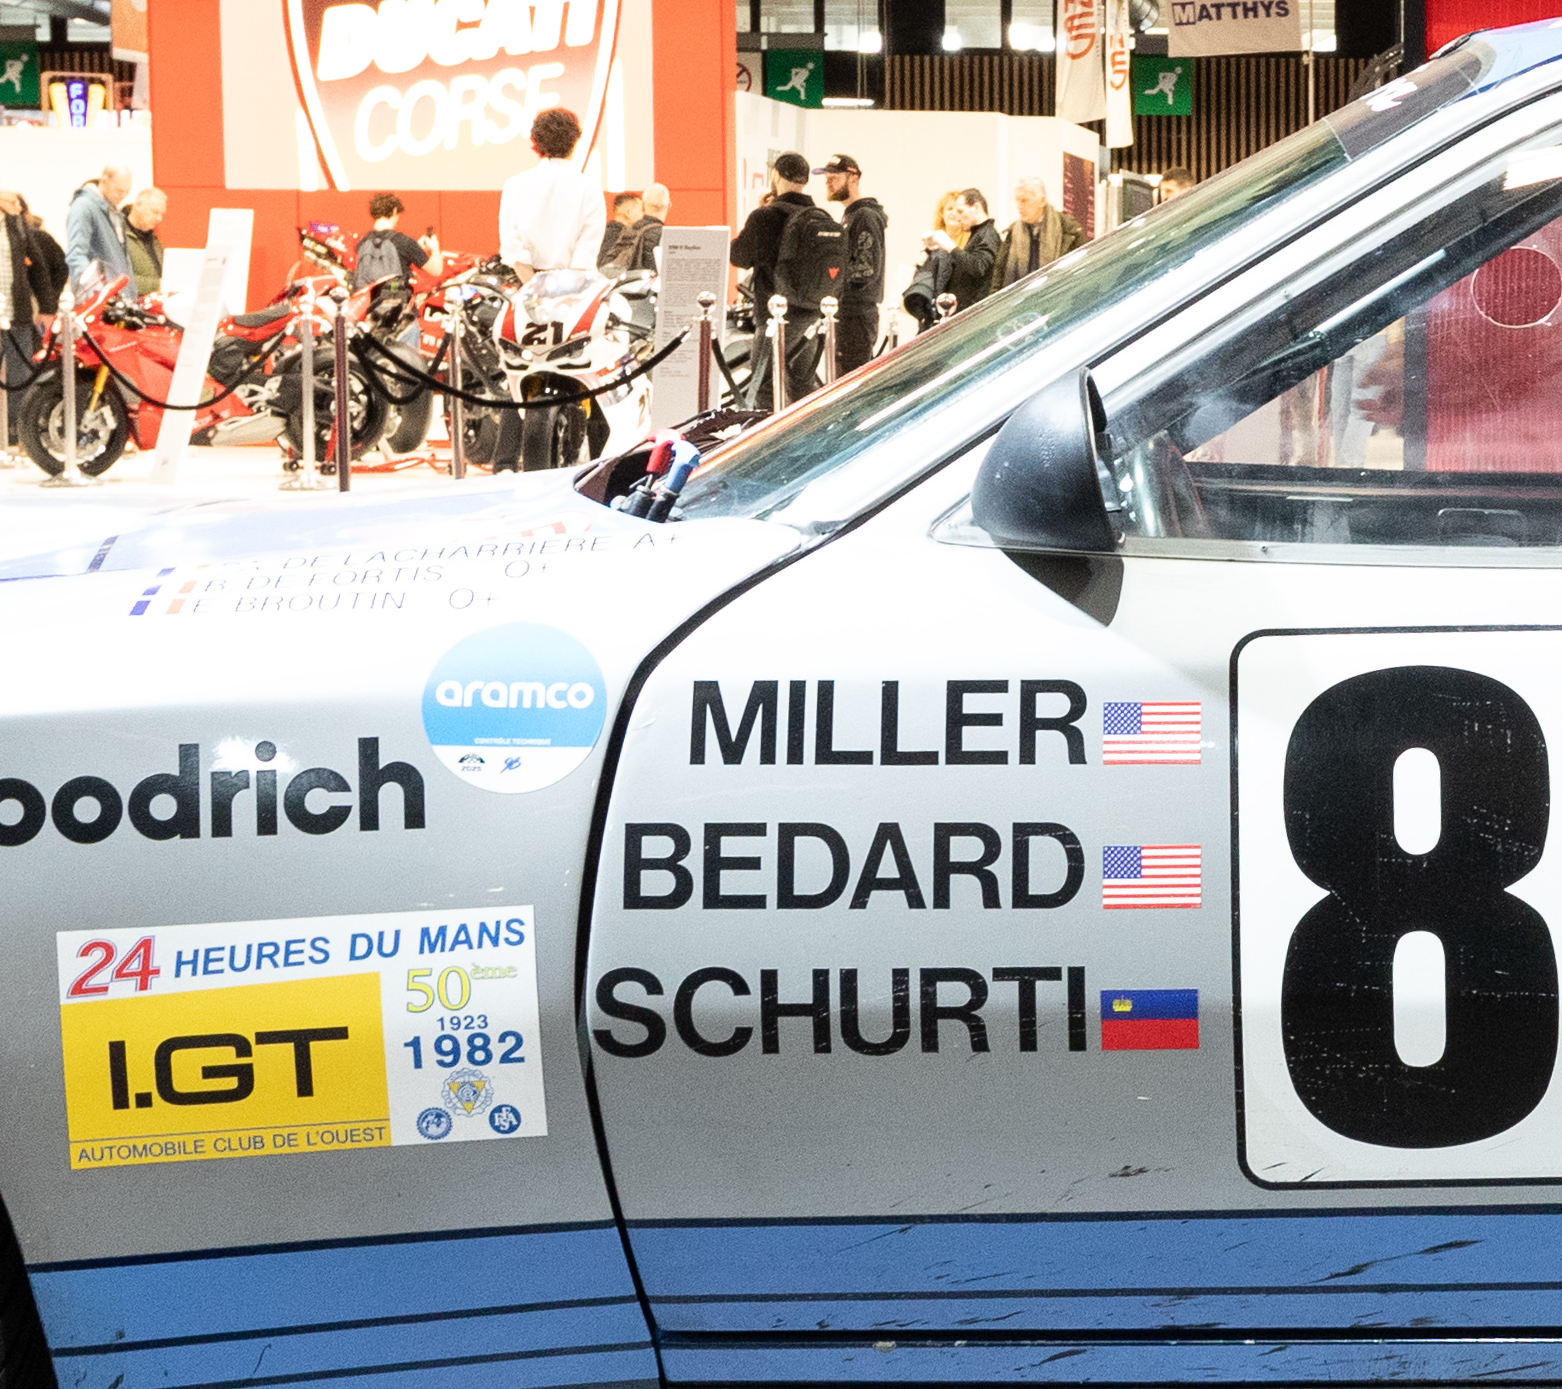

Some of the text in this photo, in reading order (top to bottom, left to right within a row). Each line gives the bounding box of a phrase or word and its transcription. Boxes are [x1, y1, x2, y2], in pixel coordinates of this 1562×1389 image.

[1171, 0, 1290, 26] MATTHYS
[354, 63, 565, 162] CORSE
[521, 321, 564, 346] 21
[344, 535, 611, 566] LACHARRIERE
[307, 565, 444, 587] FORTIS
[234, 590, 407, 613] BROUTIN
[436, 680, 594, 709] aramco
[690, 679, 1088, 766] MILLER
[623, 822, 1085, 910] BEDARD
[65, 918, 526, 1000] 24 HEURES DU MANS
[436, 1014, 490, 1031] 1923
[591, 966, 1086, 1058] SCHURTI
[109, 1026, 349, 1111] I.GT
[403, 1030, 526, 1070] 1982
[77, 1126, 388, 1164] AUTOMOBILE CLUB DE L'OUEST
